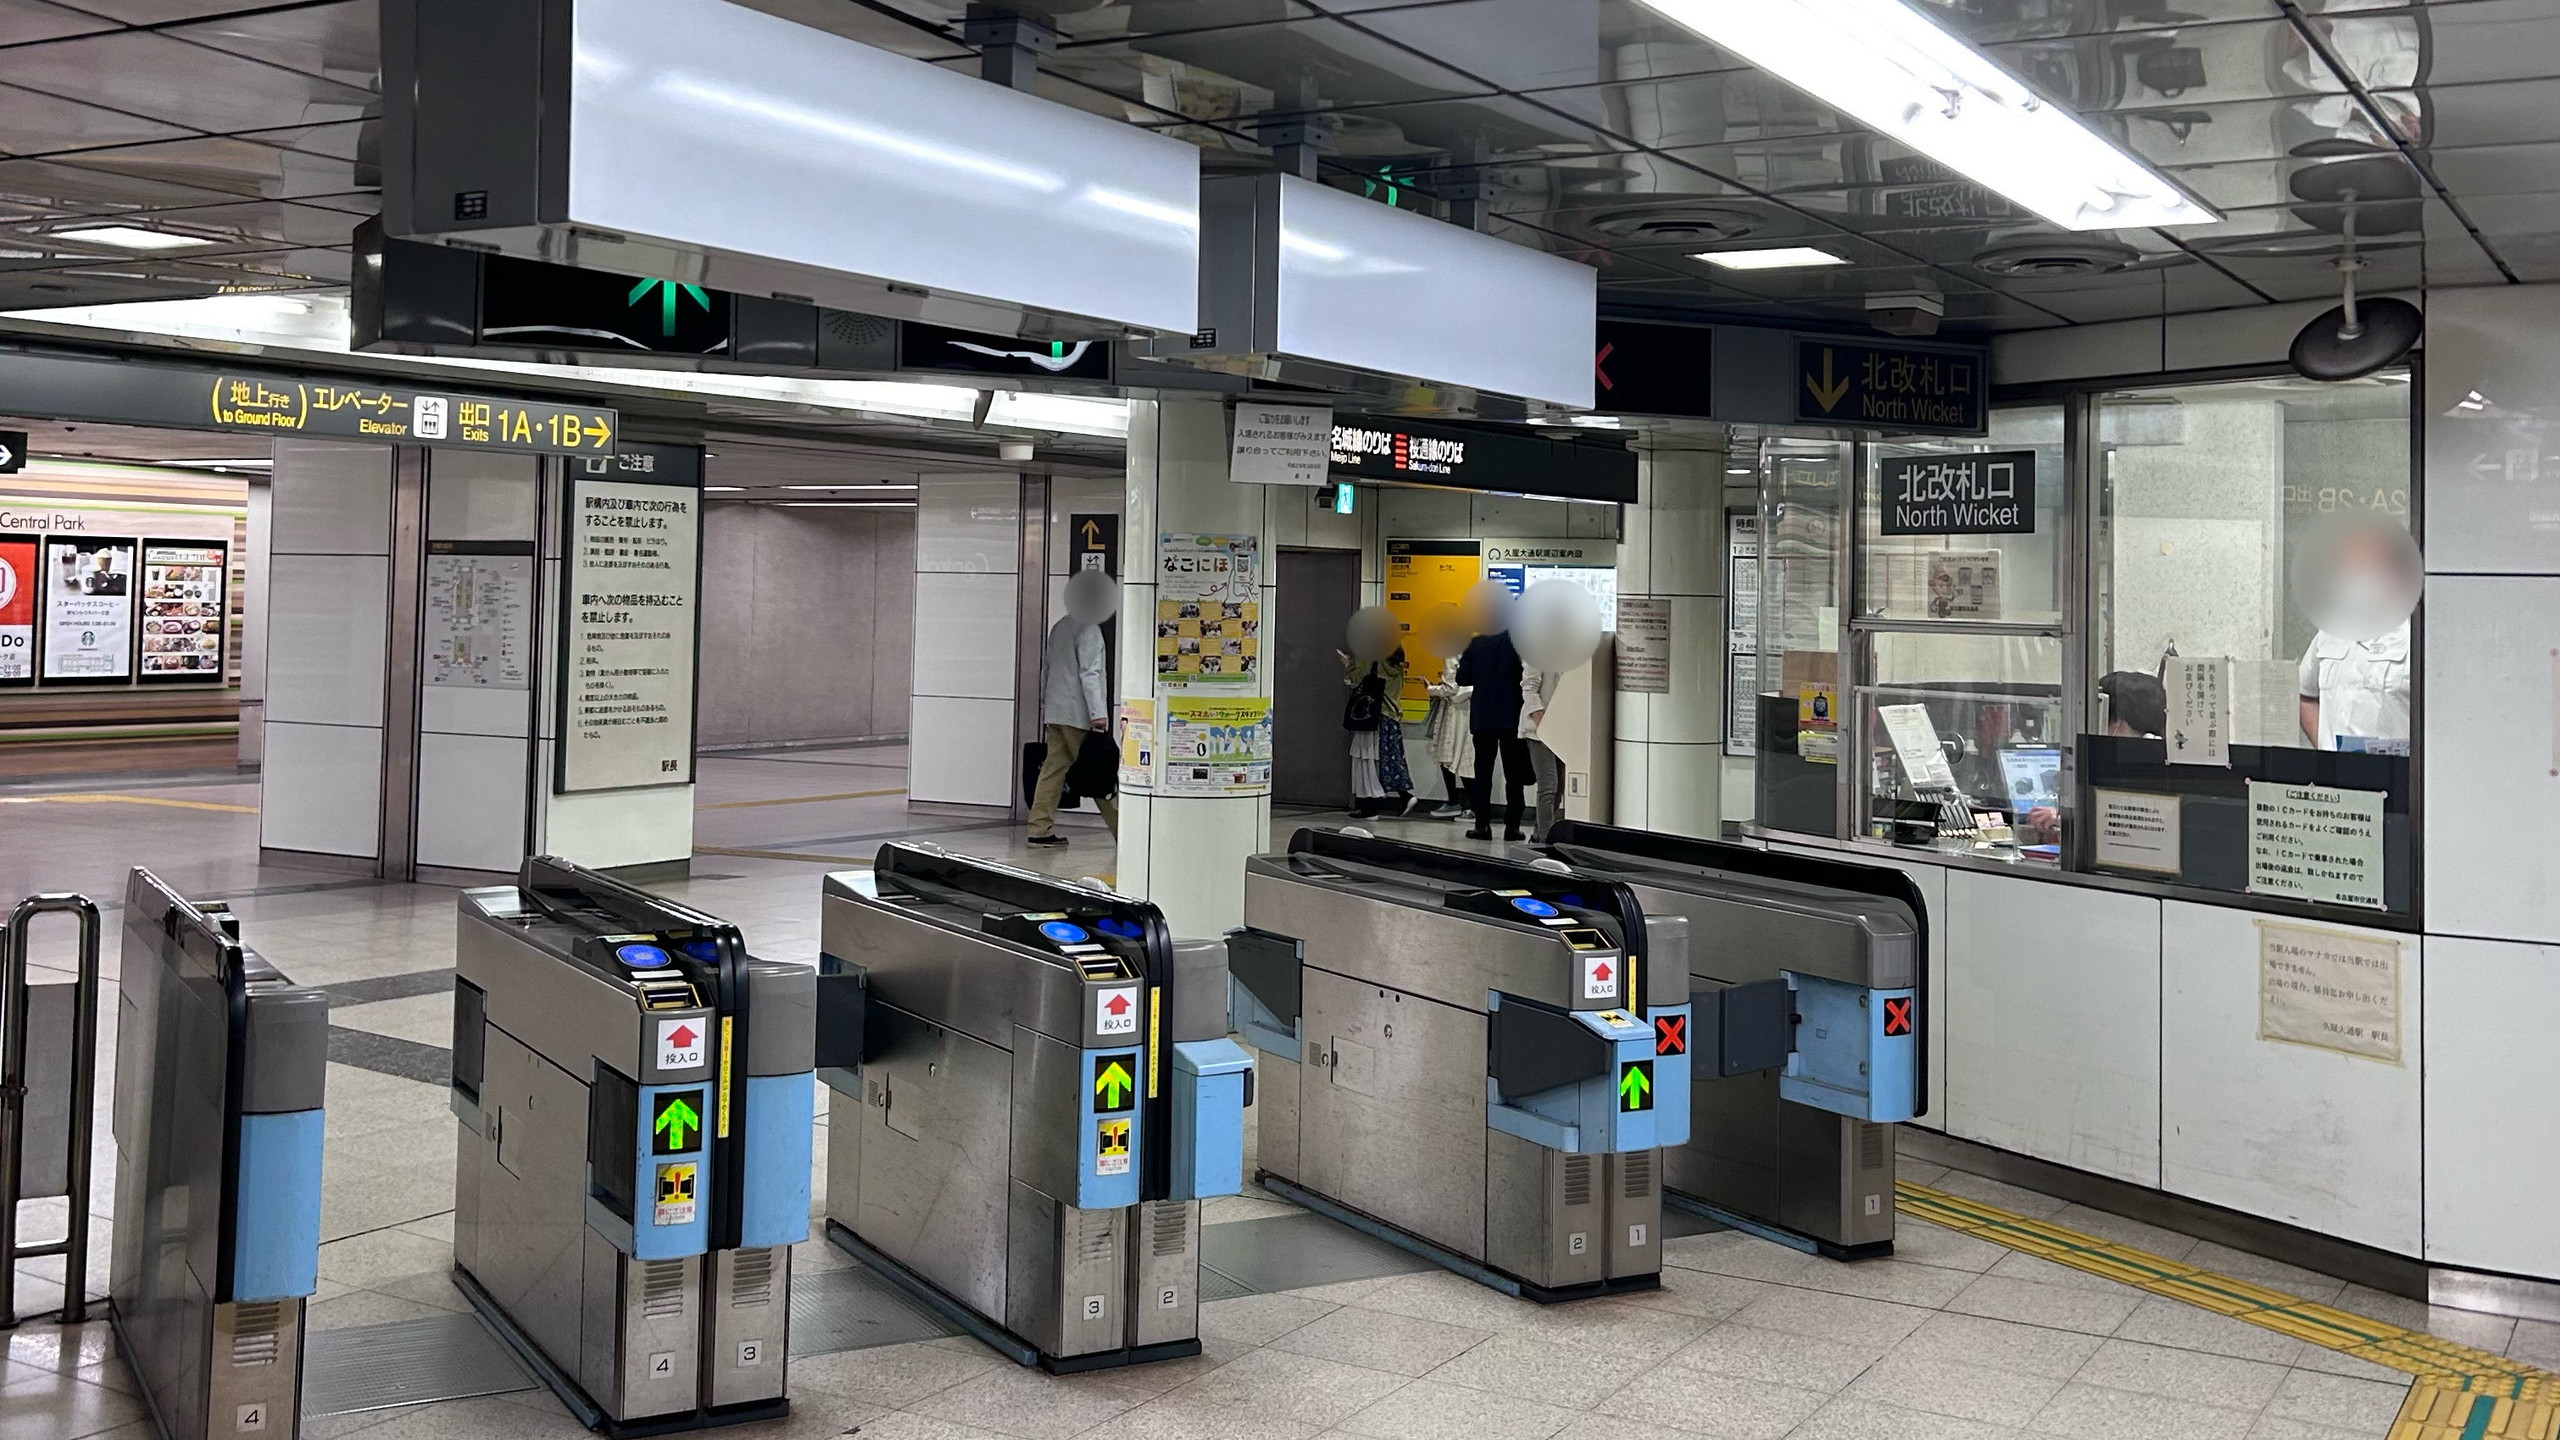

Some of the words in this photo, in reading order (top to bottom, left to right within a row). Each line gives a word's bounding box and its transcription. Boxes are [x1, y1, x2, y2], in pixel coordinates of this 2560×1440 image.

[1862, 353, 1971, 395] 北改札口
[313, 388, 408, 415] エレベーター
[459, 402, 490, 427] 出口
[1863, 394, 1908, 418] North
[1912, 401, 1964, 424] Wicket
[223, 410, 234, 424] to
[236, 411, 270, 426] Ground
[271, 413, 296, 428] Floor
[360, 419, 407, 436] Elevator
[463, 427, 489, 442] Exits
[1331, 426, 1391, 456] 名城線のりば
[1409, 436, 1464, 464] 桜通線のりば
[619, 454, 654, 472] ご注意
[1348, 453, 1361, 465] Line
[1439, 462, 1451, 474] Line
[1899, 462, 2014, 503] 北改札口
[54, 514, 85, 531] Park
[585, 515, 668, 529] することを禁止します。
[1896, 505, 1947, 527] North
[1953, 503, 2019, 527] Wicket
[582, 594, 683, 606] 車内へ次の物品を持込むこと
[582, 612, 633, 623] を禁止します。
[2256, 817, 2371, 838] 使用されるカードをよくご確認のうえ
[2256, 833, 2304, 846] ご利用ください。
[2255, 876, 2304, 890] ご注意ください。
[1591, 985, 1613, 994] 投入口
[1104, 1019, 1131, 1030] 投入口
[665, 1053, 698, 1065] 投入口
[1870, 1198, 1876, 1210] 1
[1573, 1237, 1583, 1249] 2
[1635, 1229, 1641, 1241] 1
[1089, 1300, 1099, 1314] 3
[1163, 1290, 1174, 1304] 2
[656, 1358, 669, 1373] 4
[744, 1346, 756, 1361] 3
[244, 1409, 260, 1425] 4
